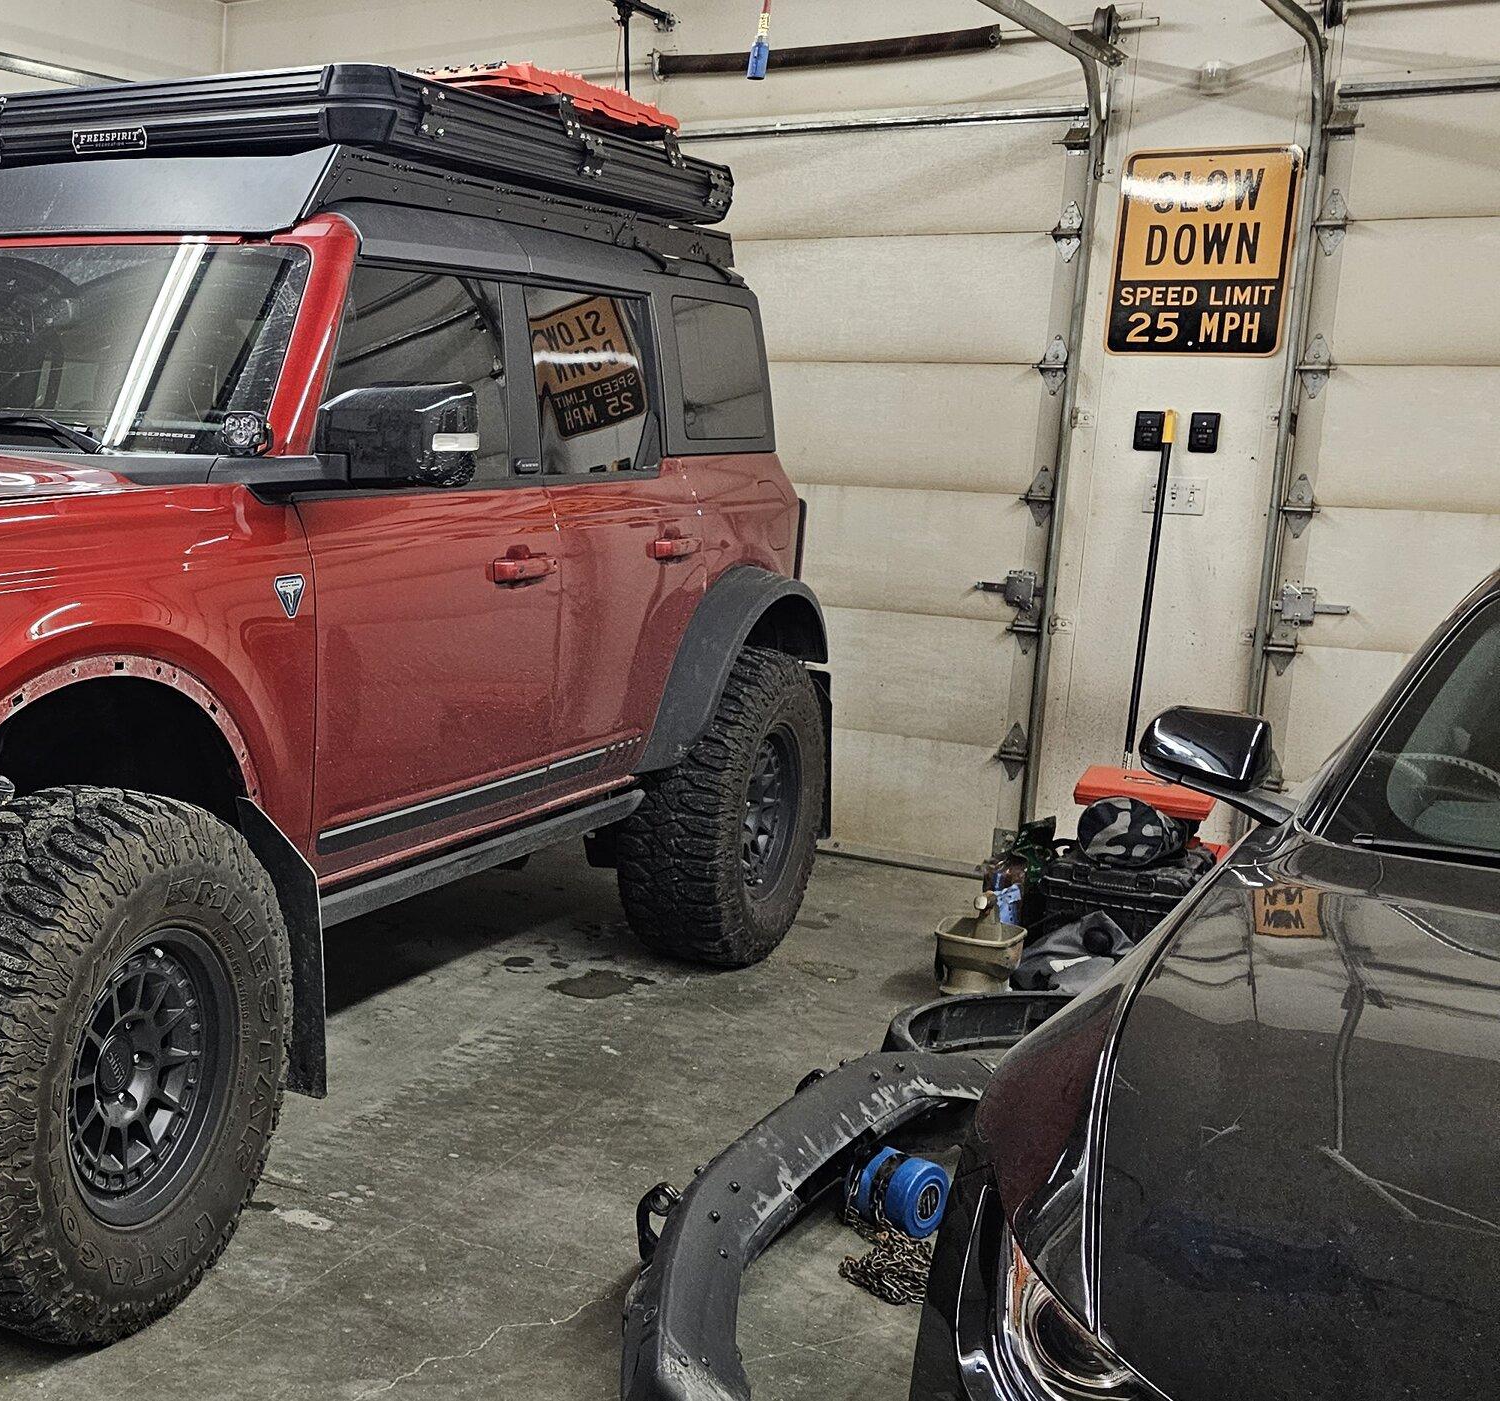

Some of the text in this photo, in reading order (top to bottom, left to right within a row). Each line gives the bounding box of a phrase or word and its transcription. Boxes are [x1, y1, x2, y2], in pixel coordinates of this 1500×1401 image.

[80, 131, 139, 144] FREESPIRIT
[1153, 168, 1265, 213] SLOW
[1145, 222, 1261, 266] DOWN
[1119, 285, 1275, 306] SPEED LIMIT
[1126, 312, 1261, 343] 25 MPH
